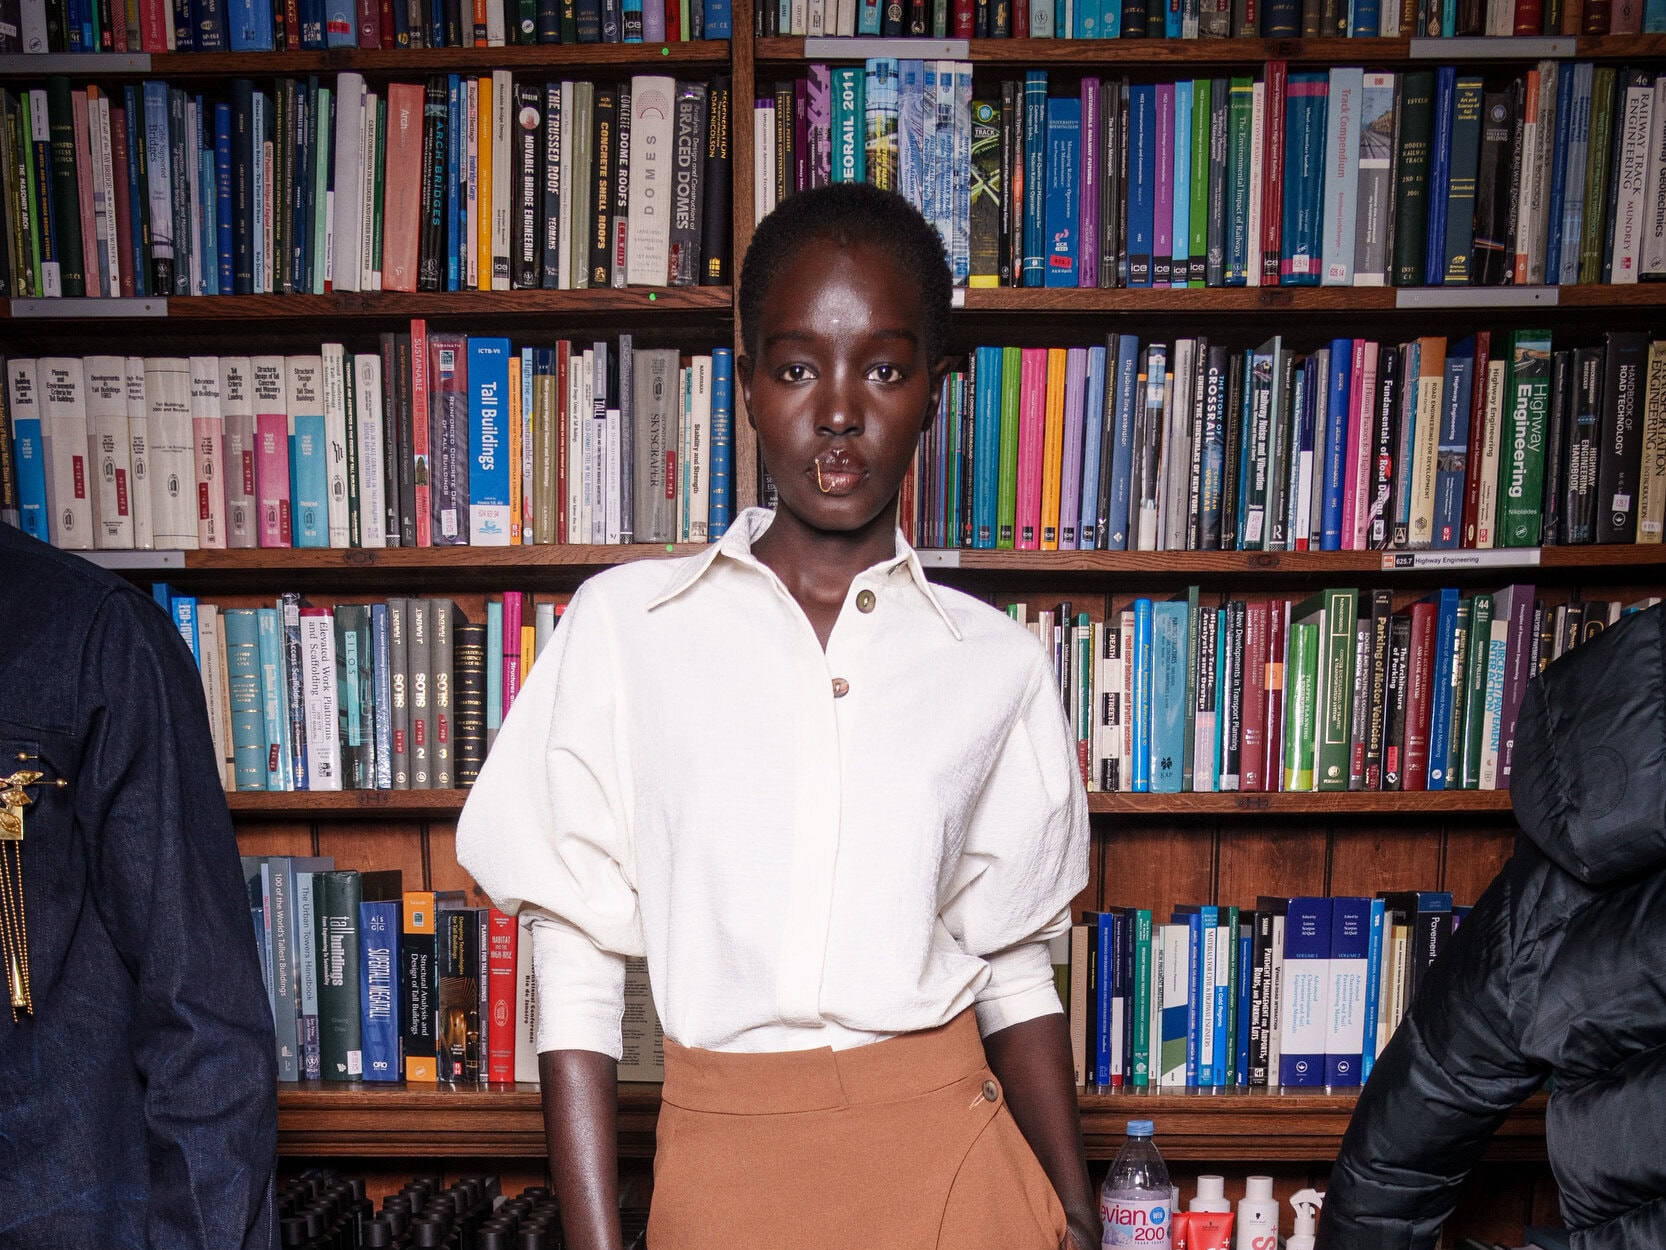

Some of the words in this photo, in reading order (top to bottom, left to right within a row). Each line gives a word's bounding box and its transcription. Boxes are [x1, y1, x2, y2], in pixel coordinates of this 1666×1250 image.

[843, 71, 854, 110] 2011
[1636, 76, 1648, 85] 4e
[548, 89, 560, 110] THE
[620, 94, 631, 131] CONCRETE
[1340, 89, 1351, 115] Track
[548, 113, 560, 162] TRUSSED
[678, 103, 693, 167] BRACED
[1238, 115, 1247, 131] The
[1635, 93, 1650, 151] RAILWAY
[435, 122, 444, 160] ARCH
[524, 134, 534, 174] MOVABLE
[599, 122, 609, 178] CONCRETE
[619, 132, 629, 166] DOME
[1337, 115, 1350, 178] Compendium
[1623, 98, 1639, 189] ENGINEERING
[644, 135, 657, 216] DOMES
[1236, 132, 1246, 188] Environmental
[1632, 154, 1644, 194] TRACK
[20, 174, 28, 205] MASONRY
[432, 166, 443, 226] BRIDGES
[524, 176, 534, 208] BRIDGE
[547, 164, 559, 195] ROOF
[599, 180, 607, 211] SHELL
[618, 168, 629, 207] ROOFS
[676, 171, 690, 230] DOMES
[1235, 189, 1244, 214] Impact
[524, 209, 534, 263] ENGINEERING
[548, 217, 557, 250] YEOMANS
[598, 215, 606, 250] ROOFS
[1236, 215, 1244, 225] of
[1624, 200, 1634, 250] MUNDREY
[1233, 225, 1243, 258] Railways
[1130, 263, 1147, 272] ice
[1154, 265, 1170, 273] ice
[1190, 263, 1205, 271] ice
[415, 338, 423, 392] SUSTAINABLE
[1125, 359, 1133, 371] the
[1618, 365, 1628, 391] ROAD
[481, 382, 498, 405] Tall
[1123, 371, 1132, 397] jubilee
[1197, 374, 1205, 401] UNDER
[1489, 368, 1500, 405] Highway
[1626, 365, 1636, 416] HANDBOOK
[1196, 401, 1204, 419] THE
[1205, 367, 1218, 443] CROSSRAIL
[1258, 389, 1269, 419] Railway
[1380, 379, 1393, 444] Fundamentals
[1528, 384, 1547, 453] Highway
[478, 409, 499, 470] Buildings
[1121, 413, 1130, 448] extension
[1193, 419, 1203, 463] SIDEWALKS
[1258, 420, 1268, 441] Noise
[1486, 407, 1497, 457] Engineering
[1508, 384, 1532, 498] Engineering
[1615, 393, 1625, 456] TECHNOLOGY
[1625, 418, 1632, 431] OF
[1258, 442, 1267, 456] and
[1380, 446, 1389, 456] of
[1193, 463, 1200, 475] OF
[1256, 457, 1266, 491] Vibration
[1378, 458, 1390, 482] Road
[1569, 444, 1581, 492] HANDBOOK
[1579, 439, 1590, 495] ENGINEERING
[1588, 447, 1597, 487] HIGHWAY
[1192, 475, 1200, 494] NEW
[1375, 484, 1388, 516] Design
[1191, 494, 1199, 515] YORK
[1415, 556, 1441, 566] Highway
[1442, 556, 1479, 565] Engineering
[1236, 611, 1244, 628] New
[1478, 600, 1489, 609] 44
[308, 622, 316, 640] and
[319, 622, 328, 663] Elevated
[1201, 612, 1209, 655] Analysis
[1208, 612, 1216, 655] Highway
[1374, 616, 1387, 659] Parking
[347, 634, 356, 675] SILOS
[1233, 629, 1244, 678] Developments
[1375, 660, 1384, 673] of
[1393, 647, 1398, 657] of
[309, 643, 319, 696] Scaffolding
[321, 667, 331, 692] Work
[1207, 656, 1215, 688] Traffic
[1234, 678, 1242, 686] in
[1389, 659, 1398, 689] Parking
[1397, 662, 1407, 710] Architecture
[1485, 640, 1497, 712] INTERACTION
[393, 673, 405, 709] SILOS
[415, 673, 426, 708] SILOS
[437, 672, 448, 708] SILOS
[1199, 676, 1208, 710] Design
[1232, 687, 1242, 720] Transport
[1373, 672, 1384, 705] Motor
[1490, 641, 1506, 752] AIRCRAFT/PAVEMENT
[323, 695, 332, 740] Platforms
[1108, 693, 1116, 726] STREETS
[1229, 721, 1240, 751] Planning
[1371, 705, 1382, 750] Vehicles
[416, 748, 425, 759] 2
[439, 748, 447, 759] 3
[275, 873, 283, 887] 100
[275, 887, 284, 897] of
[276, 897, 284, 911] the
[276, 911, 286, 938] World's
[1428, 917, 1440, 962] Pavement
[278, 939, 287, 962] Tallest
[331, 935, 345, 986] buildings
[409, 953, 419, 979] Design
[1263, 948, 1273, 978] PAVEMENT
[278, 962, 288, 997] Buildings
[411, 980, 420, 989] of
[419, 954, 428, 989] Structural
[411, 990, 420, 1002] Tall
[419, 990, 429, 1021] Analysis
[1251, 999, 1262, 1026] PARKING
[1262, 979, 1271, 1018] MANAGEMENT
[410, 1003, 420, 1035] Buildings
[421, 1021, 430, 1036] and
[1251, 1026, 1261, 1041] LOTS
[1135, 1227, 1165, 1241] 200
